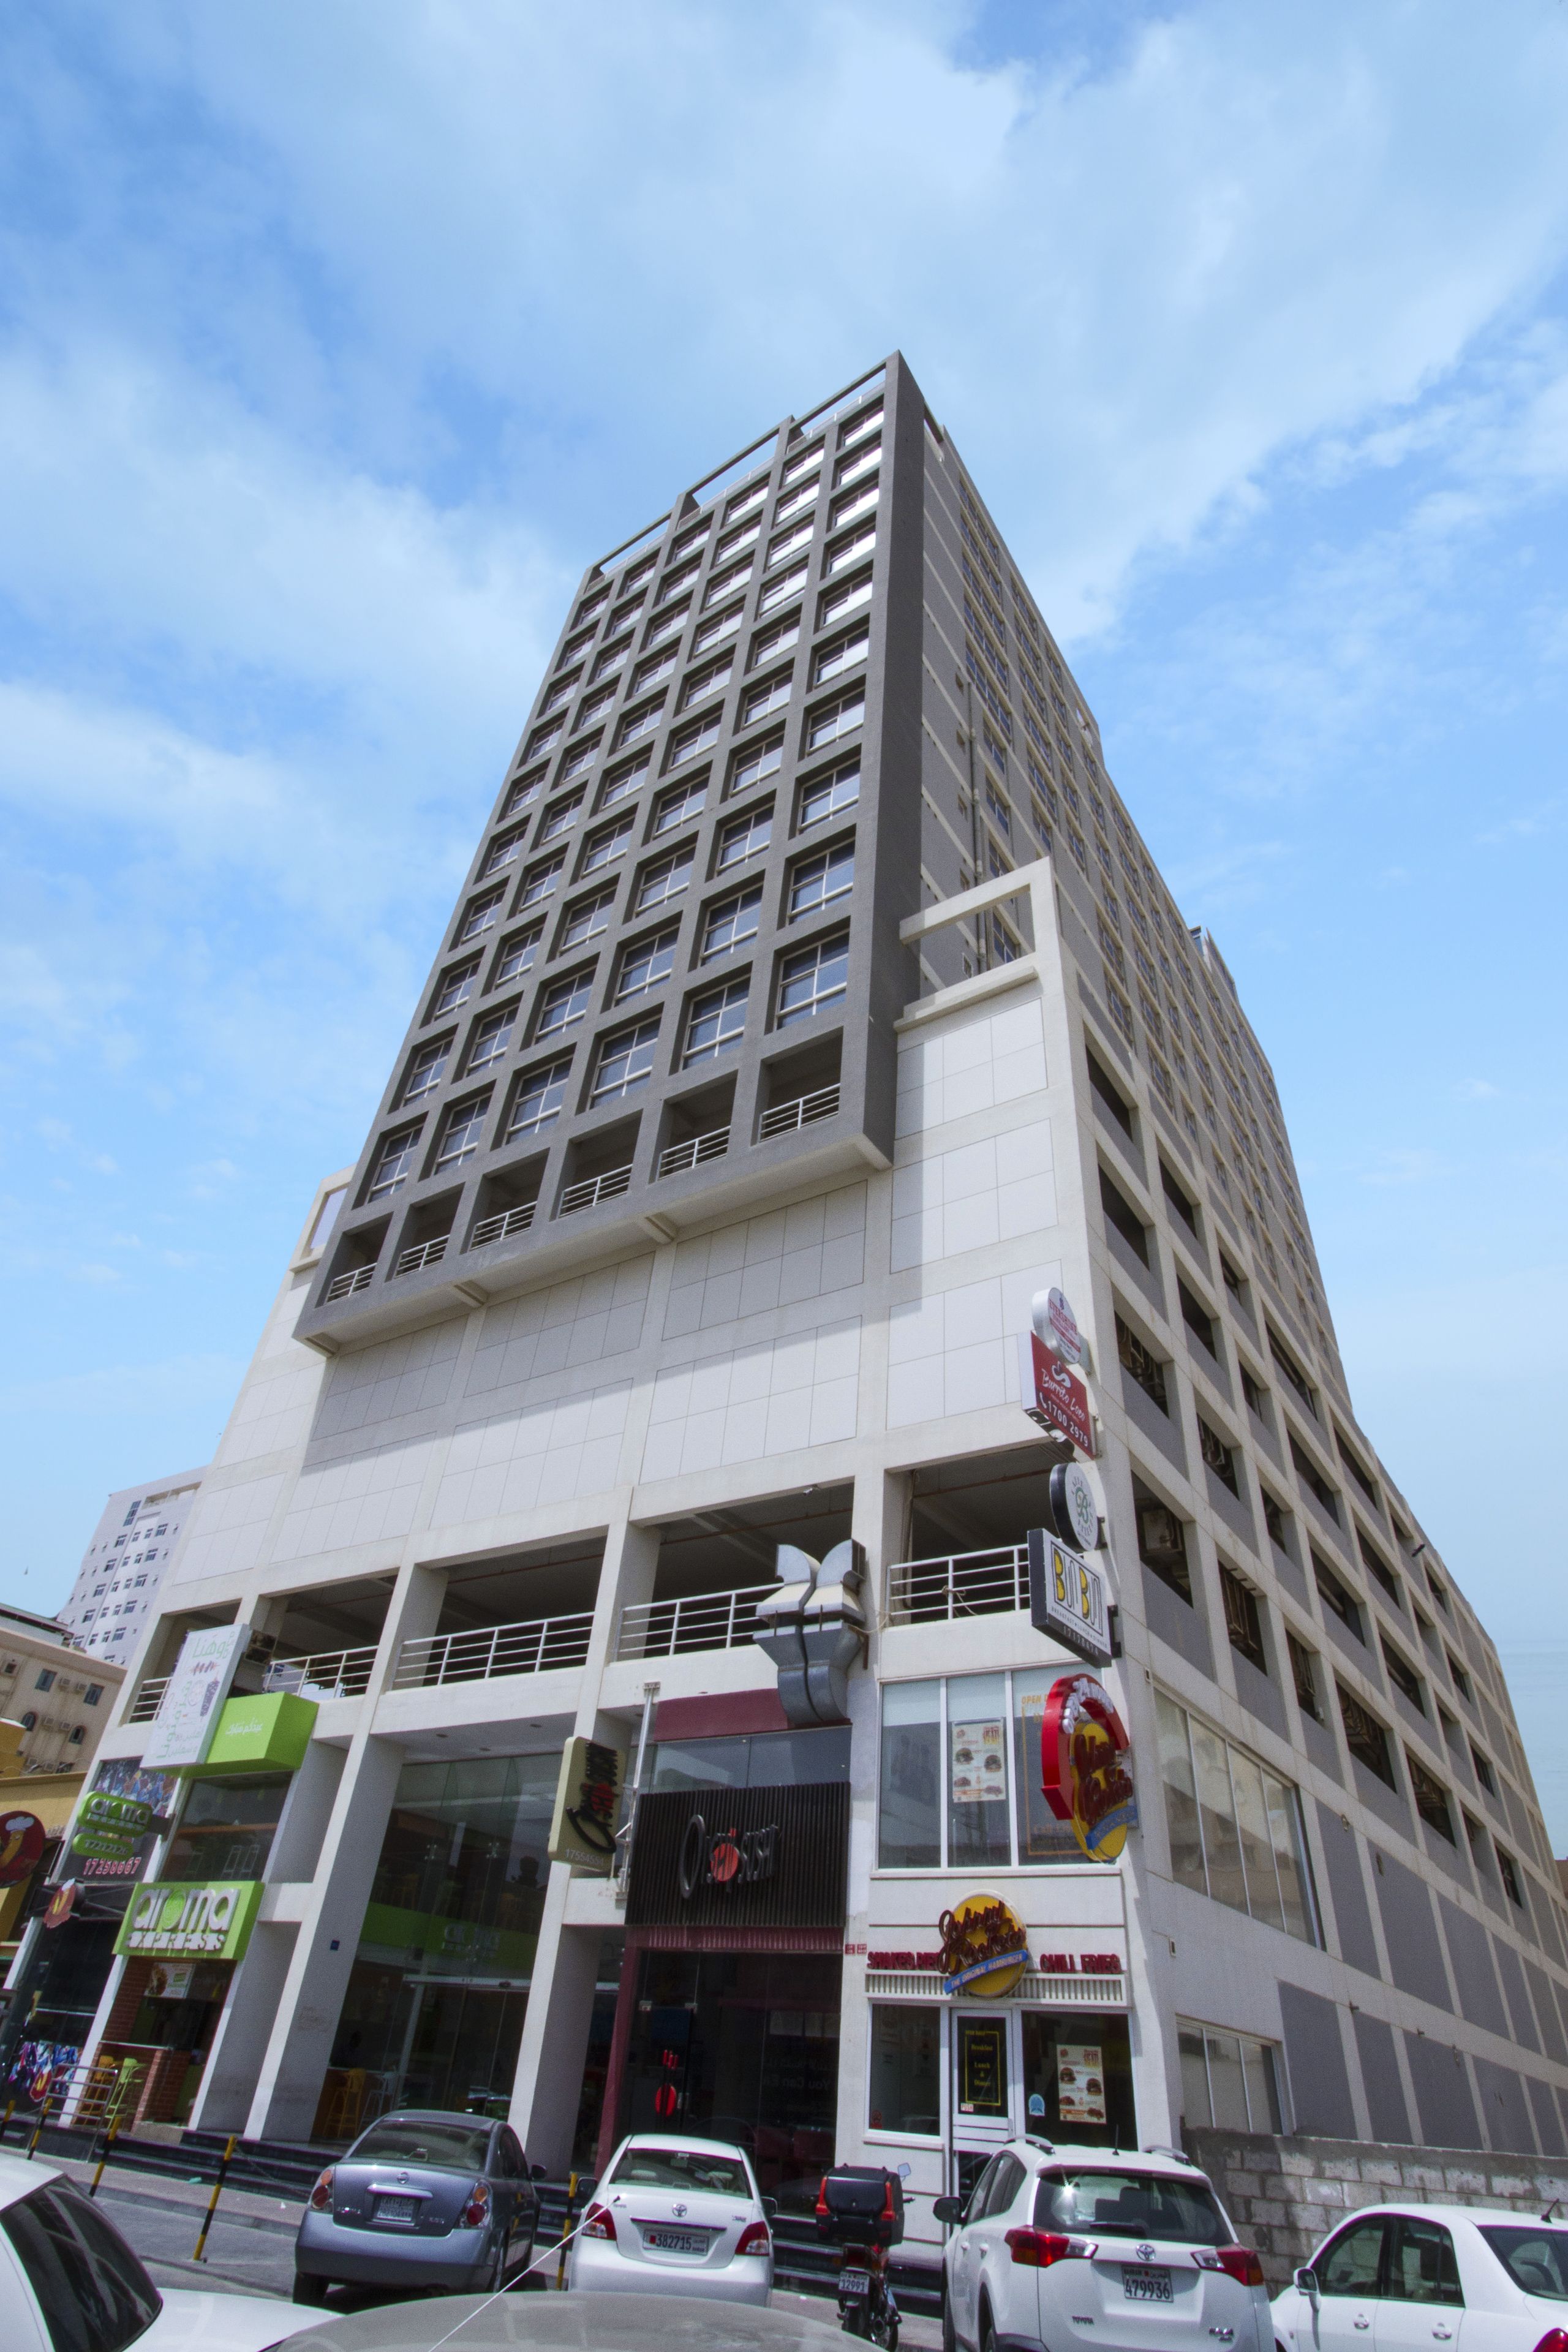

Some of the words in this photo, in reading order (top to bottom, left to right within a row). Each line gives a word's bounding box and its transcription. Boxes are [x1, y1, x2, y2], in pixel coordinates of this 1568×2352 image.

[1041, 1368, 1069, 1403] Burrito
[1047, 1401, 1068, 1427] 1700
[1069, 1422, 1088, 1447] 2979
[1021, 1695, 1041, 1705] OPEN
[91, 1798, 151, 1825] aroma
[132, 1888, 241, 1931] aroma
[124, 1931, 225, 1951] EXPRESS
[938, 1900, 1013, 1974] Johnny
[962, 1966, 986, 1981] ORIGINAL
[988, 1953, 1023, 1973] HAMBURGER
[1080, 1953, 1123, 1974] FRIES
[656, 2234, 692, 2250] 382715
[1125, 2278, 1170, 2300] 479936
[1072, 2315, 1094, 2325] TOYOTA
